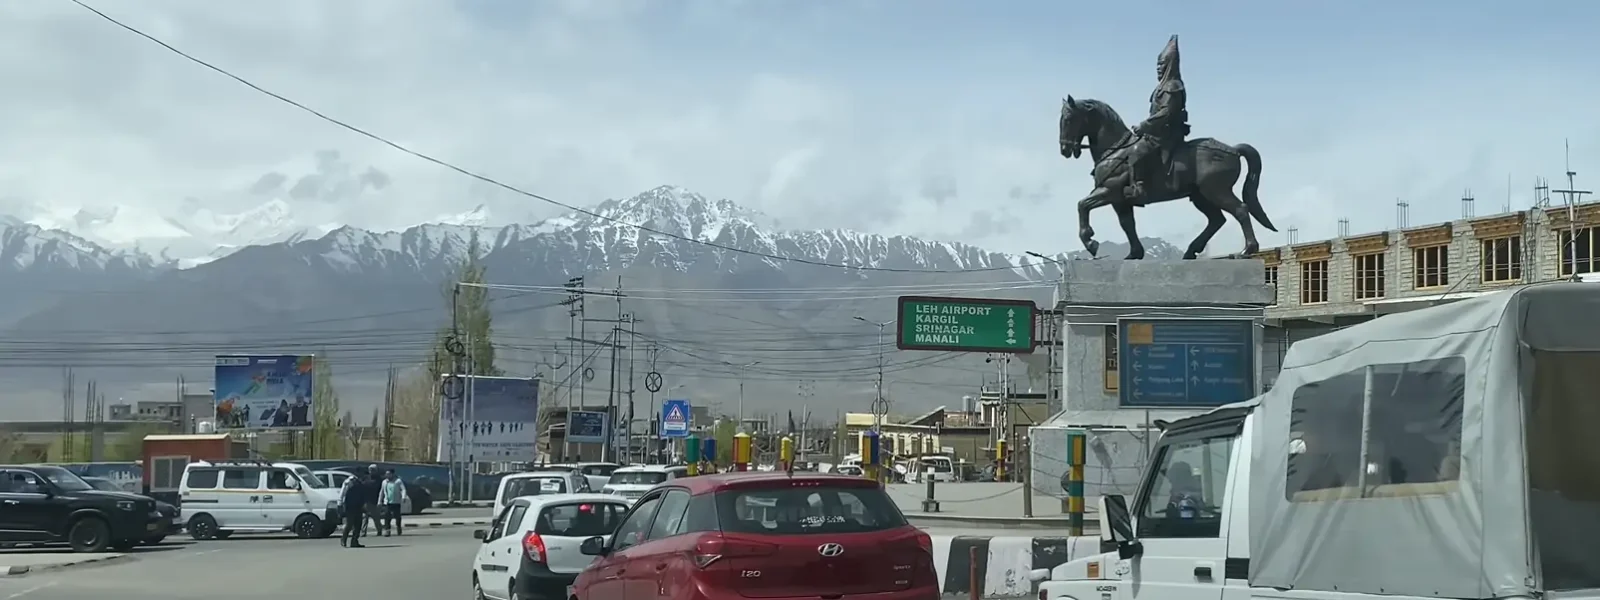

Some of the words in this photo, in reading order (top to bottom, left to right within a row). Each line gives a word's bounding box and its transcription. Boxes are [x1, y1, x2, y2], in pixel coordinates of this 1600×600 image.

[915, 304, 938, 314] LEH
[942, 306, 992, 316] AIRPORT
[915, 314, 958, 324] KARGIL
[915, 324, 974, 334] SRINAGAR
[915, 334, 959, 344] MANALI
